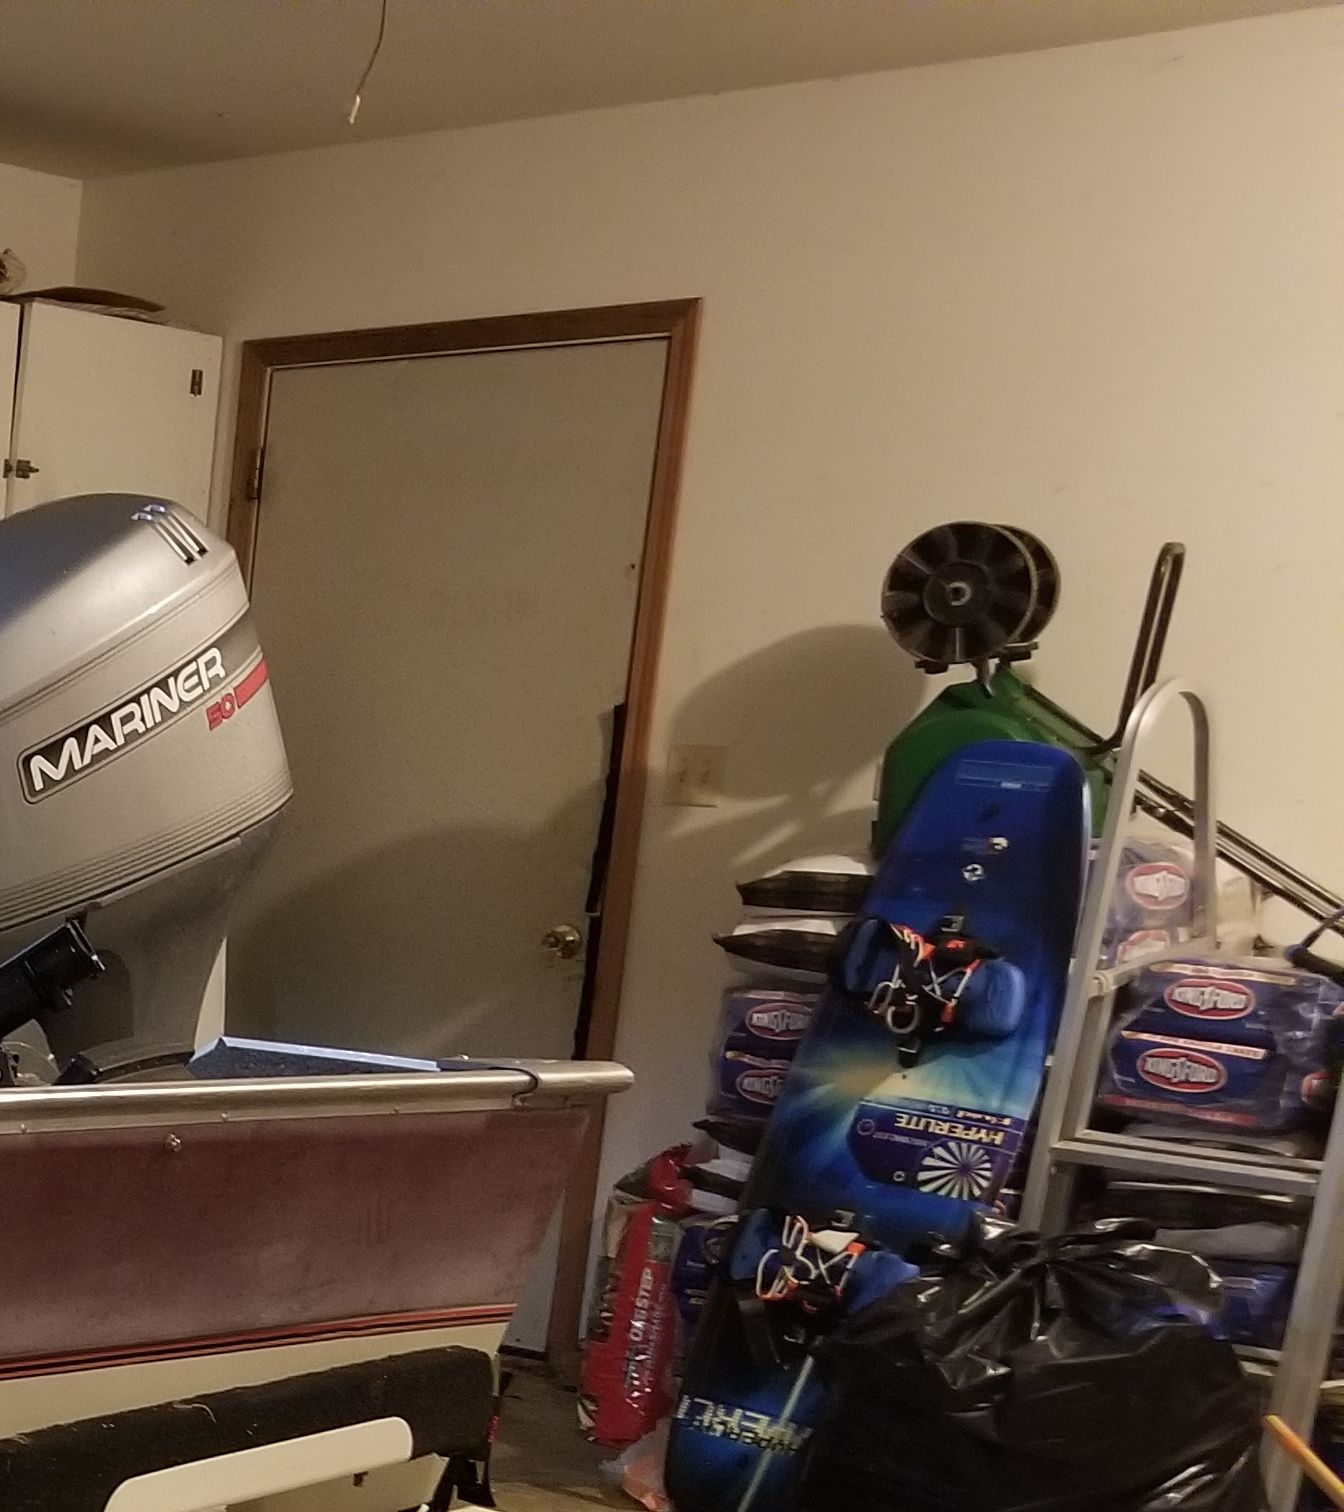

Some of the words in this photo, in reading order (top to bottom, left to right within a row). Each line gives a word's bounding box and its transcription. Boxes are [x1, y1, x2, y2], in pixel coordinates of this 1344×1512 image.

[29, 647, 226, 792] MARINER
[206, 692, 236, 731] 50
[894, 1113, 1005, 1146] HYPERLITE
